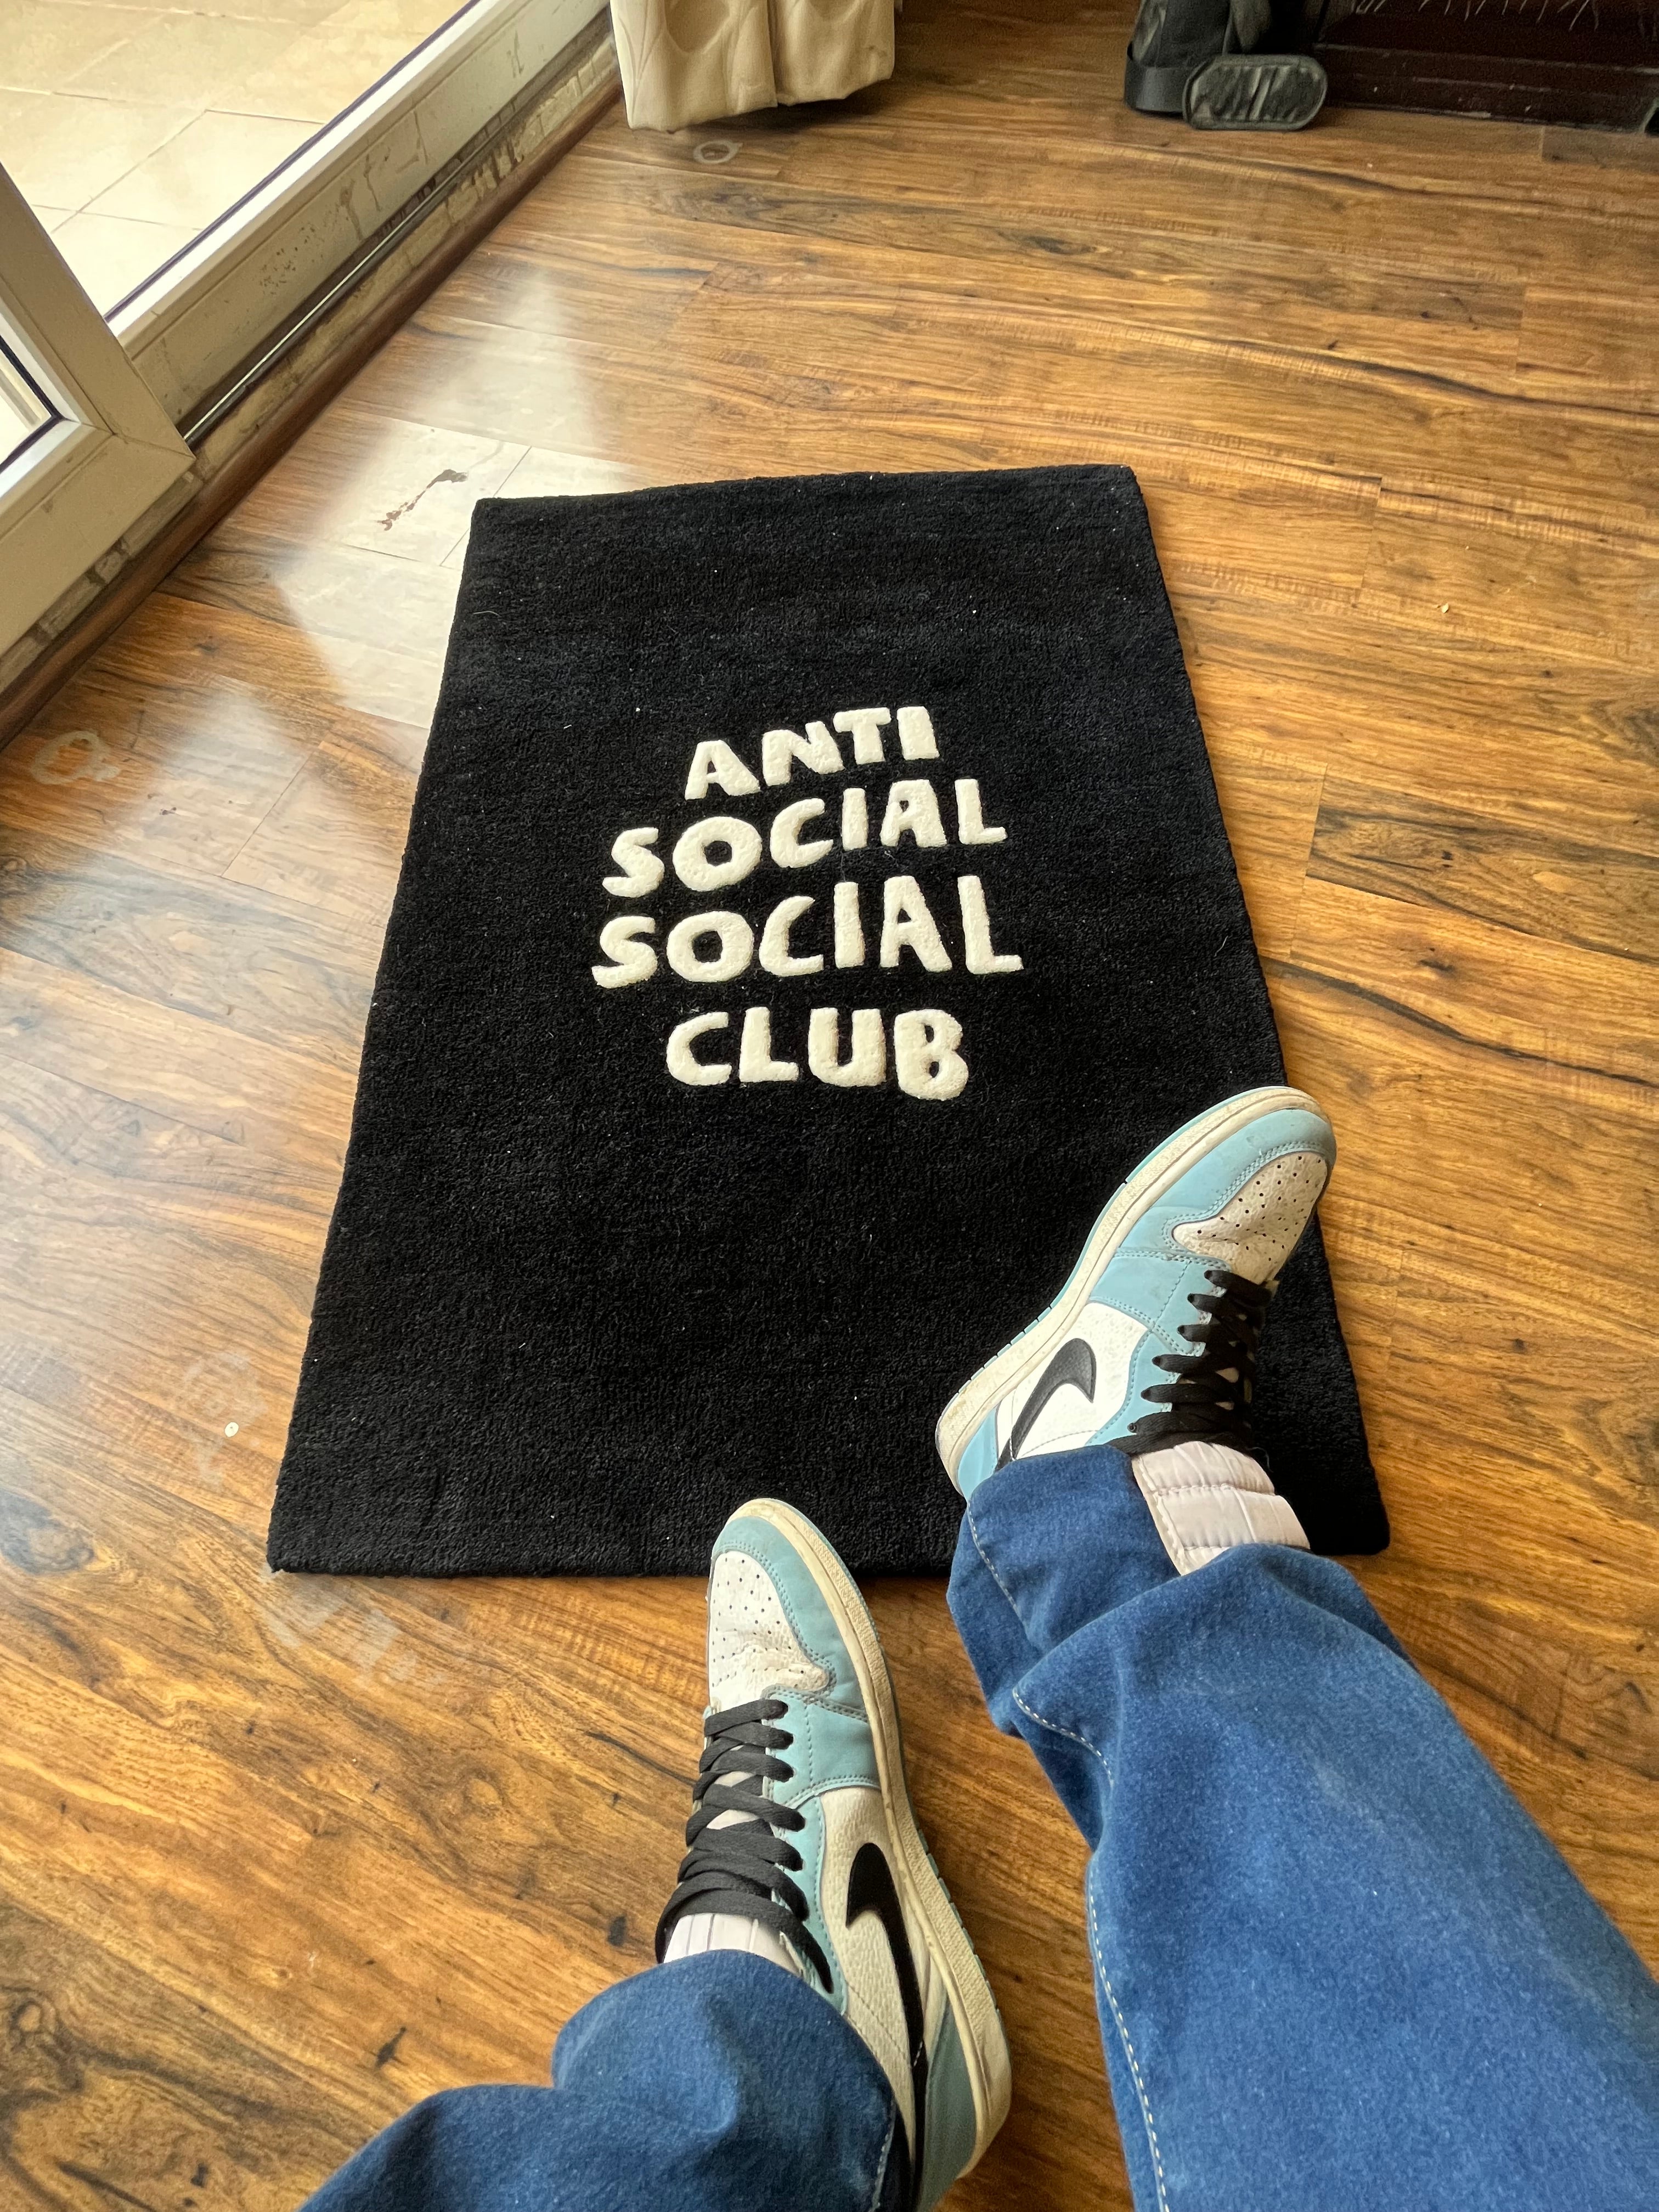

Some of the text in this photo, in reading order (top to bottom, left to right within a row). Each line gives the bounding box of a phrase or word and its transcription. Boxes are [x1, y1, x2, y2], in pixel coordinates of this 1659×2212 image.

[685, 706, 940, 800] ANTI
[602, 778, 1008, 898] SOCIAL
[591, 874, 1024, 989] SOCIAL
[665, 1007, 969, 1101] CLUB
